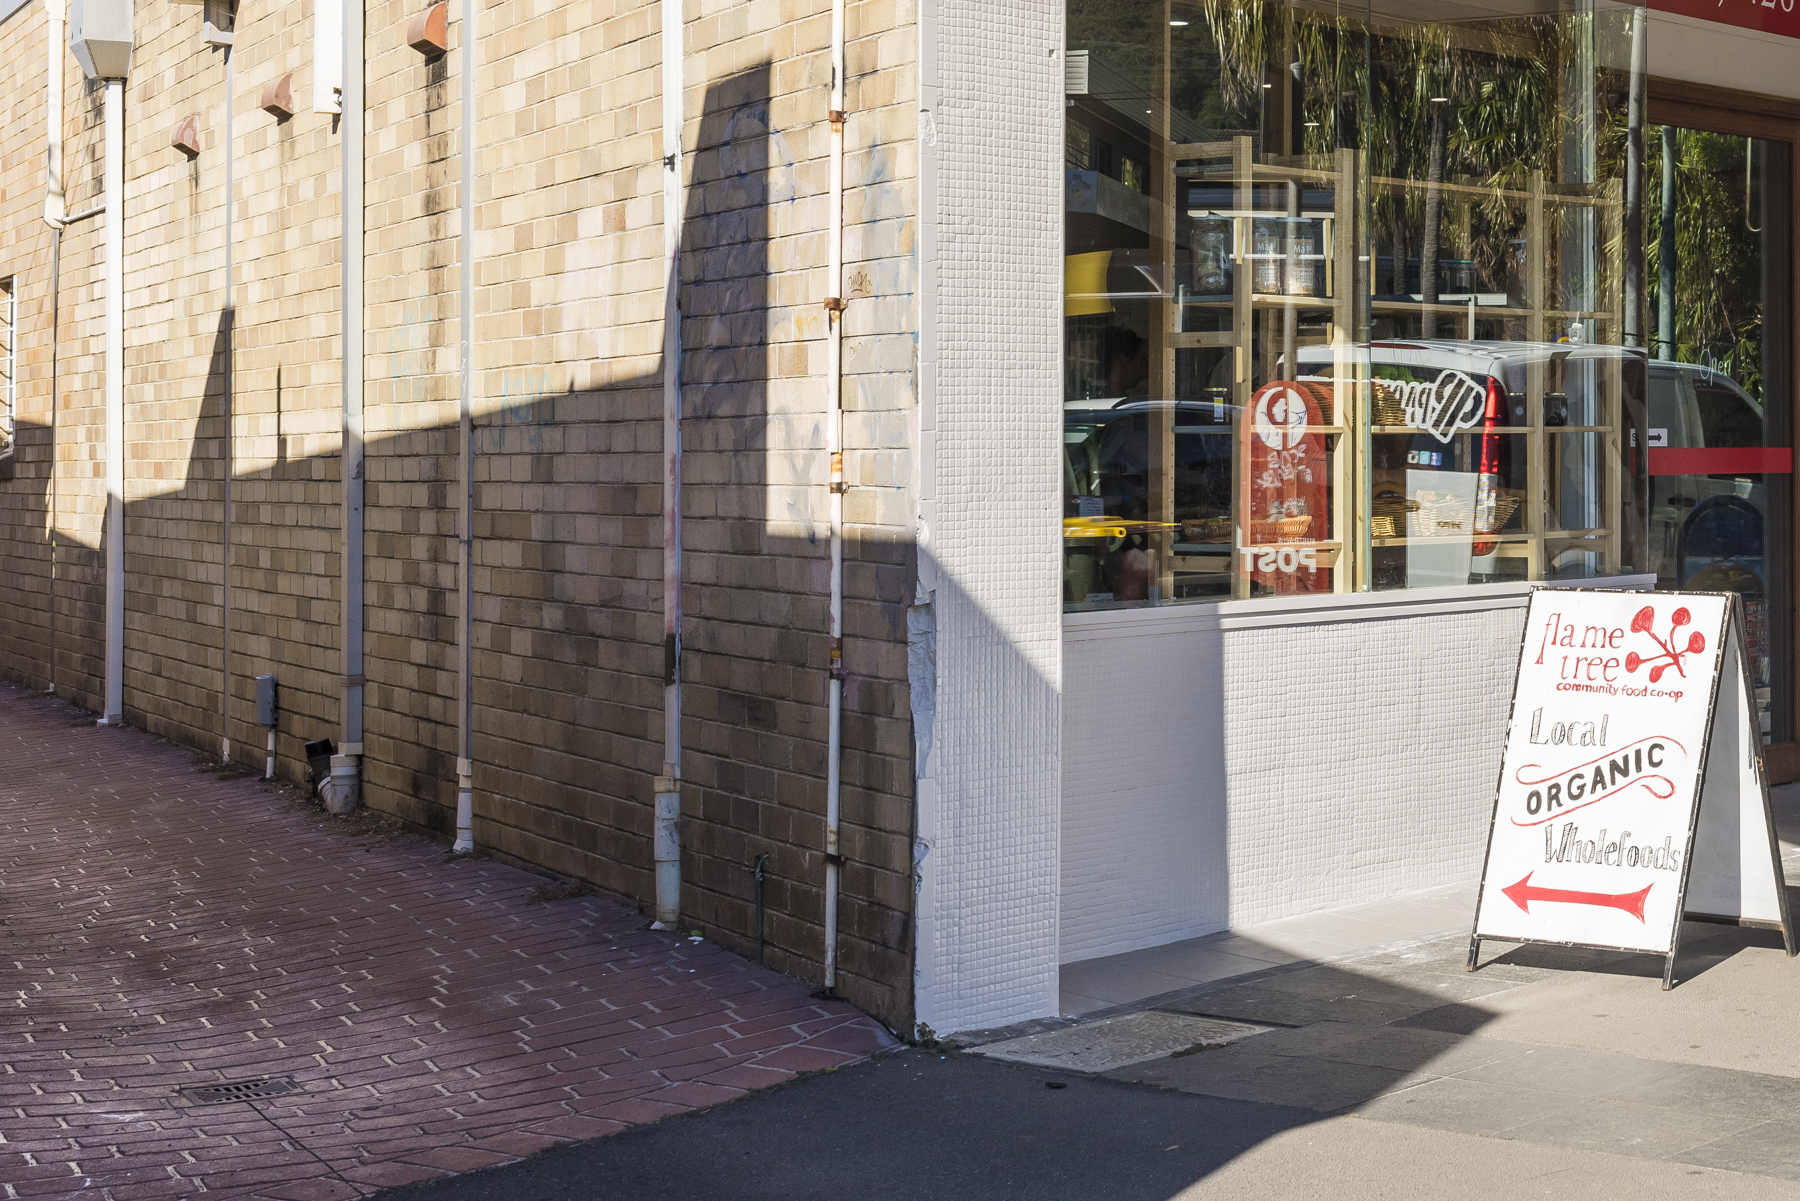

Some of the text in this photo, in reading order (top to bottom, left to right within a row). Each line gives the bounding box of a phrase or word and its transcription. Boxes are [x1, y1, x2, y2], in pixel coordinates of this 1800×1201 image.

[1700, 348, 1731, 387] Open
[1533, 612, 1625, 666] flame
[1560, 653, 1621, 683] tree
[1556, 681, 1619, 697] community
[1620, 684, 1648, 698] food
[1529, 706, 1610, 747] Local
[1525, 742, 1666, 816] ORGANIC
[1544, 821, 1680, 873] Wholefoods
